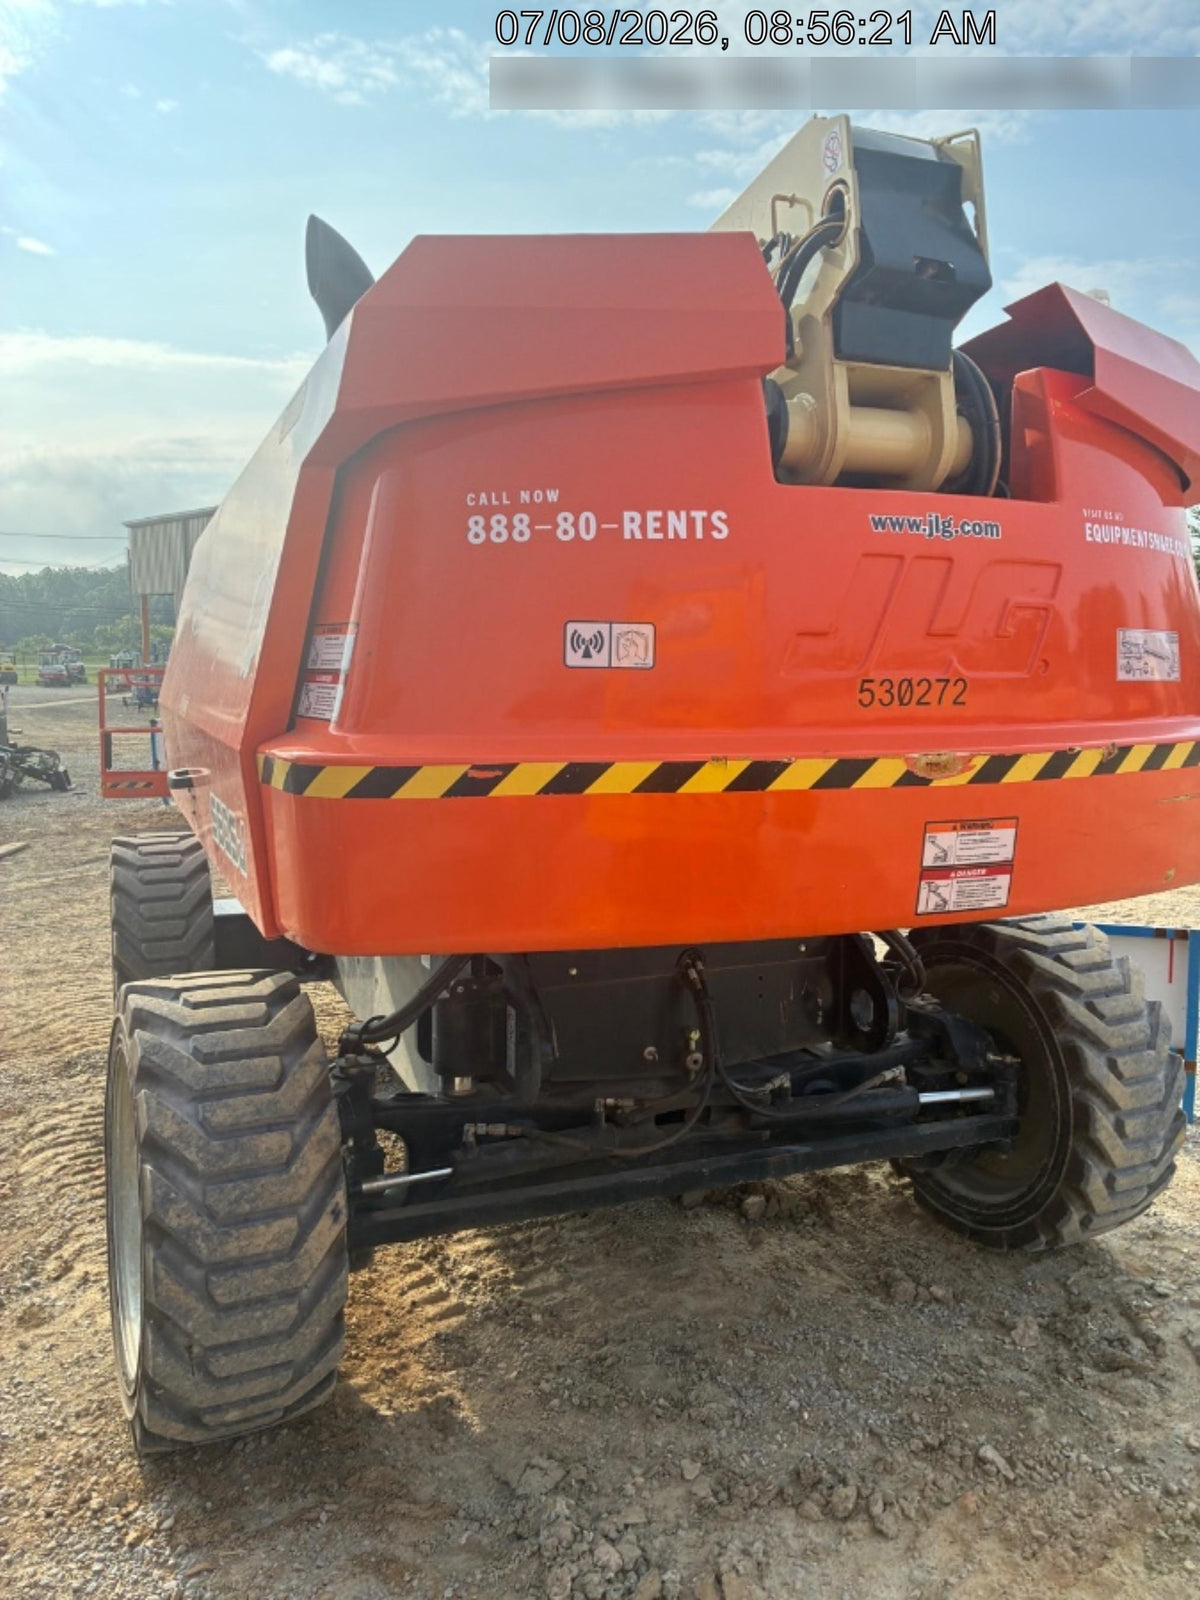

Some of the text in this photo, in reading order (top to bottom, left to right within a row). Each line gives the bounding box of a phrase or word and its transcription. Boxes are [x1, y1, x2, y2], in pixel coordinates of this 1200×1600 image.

[466, 488, 560, 506] CALL NOW
[869, 513, 1003, 539] www.jlg.com
[857, 677, 968, 708] 530272
